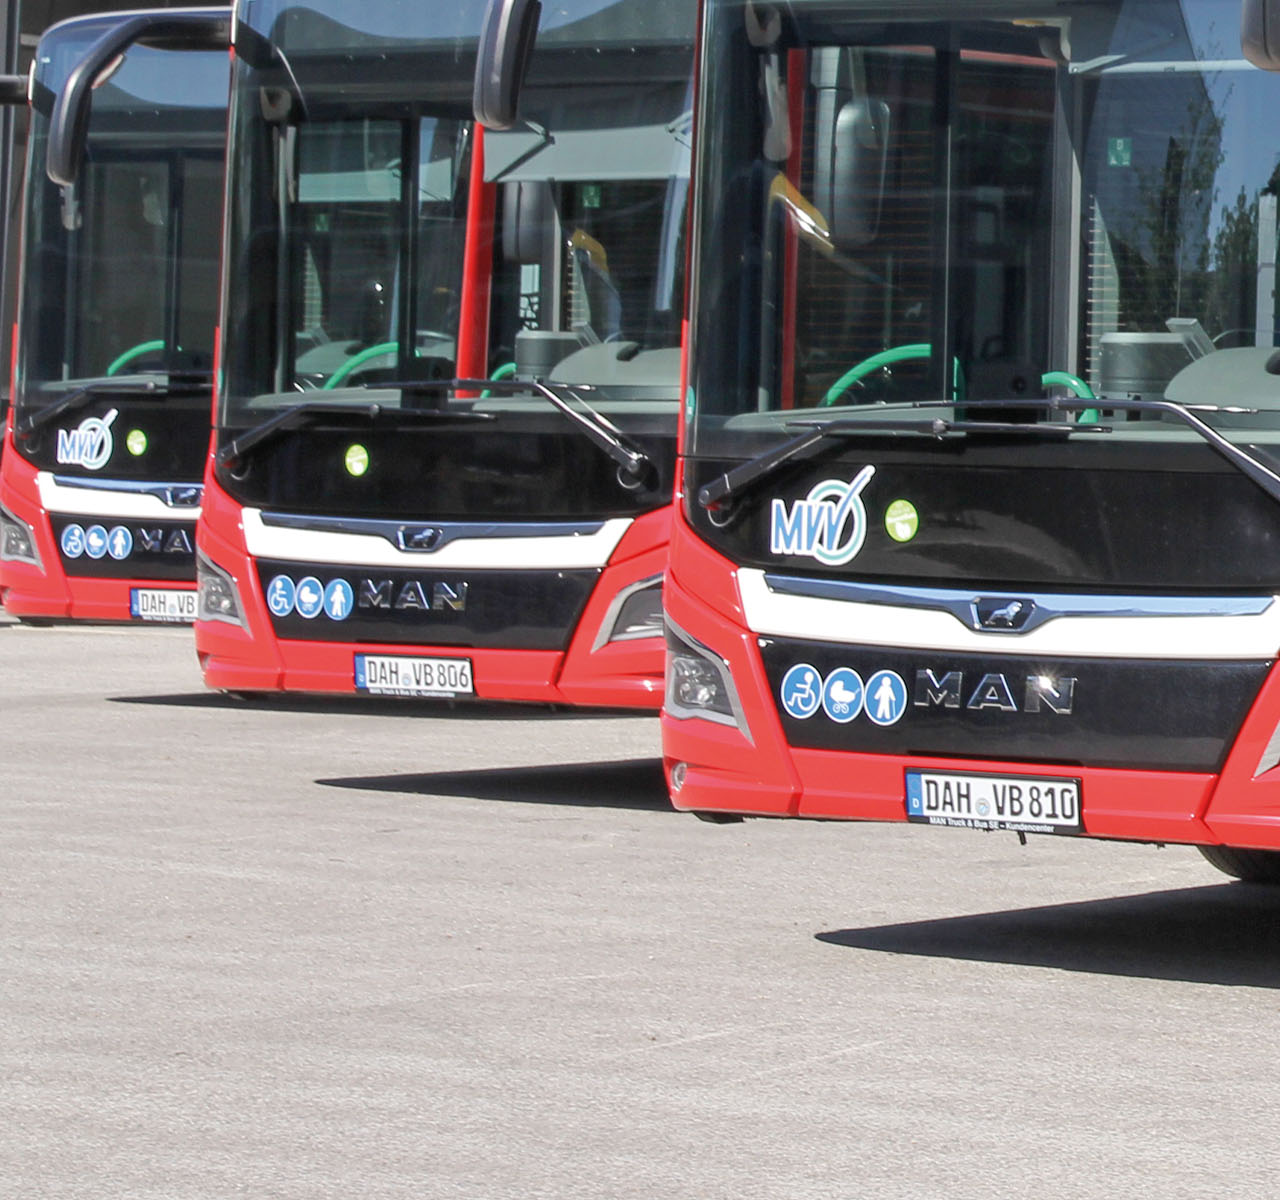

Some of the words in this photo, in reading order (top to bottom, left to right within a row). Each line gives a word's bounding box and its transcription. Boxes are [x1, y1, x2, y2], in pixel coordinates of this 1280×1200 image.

[140, 592, 167, 613] DAH
[177, 594, 195, 614] VB
[358, 579, 469, 610] MAN
[368, 660, 399, 685] DAH
[412, 662, 434, 686] VB
[437, 664, 469, 688] 806
[914, 669, 1077, 714] MAN
[925, 779, 972, 814] DAH
[992, 784, 1024, 816] VB
[1029, 786, 1075, 820] 810
[929, 816, 947, 825] MAN
[948, 818, 966, 827] Truck
[974, 820, 988, 829] Bus
